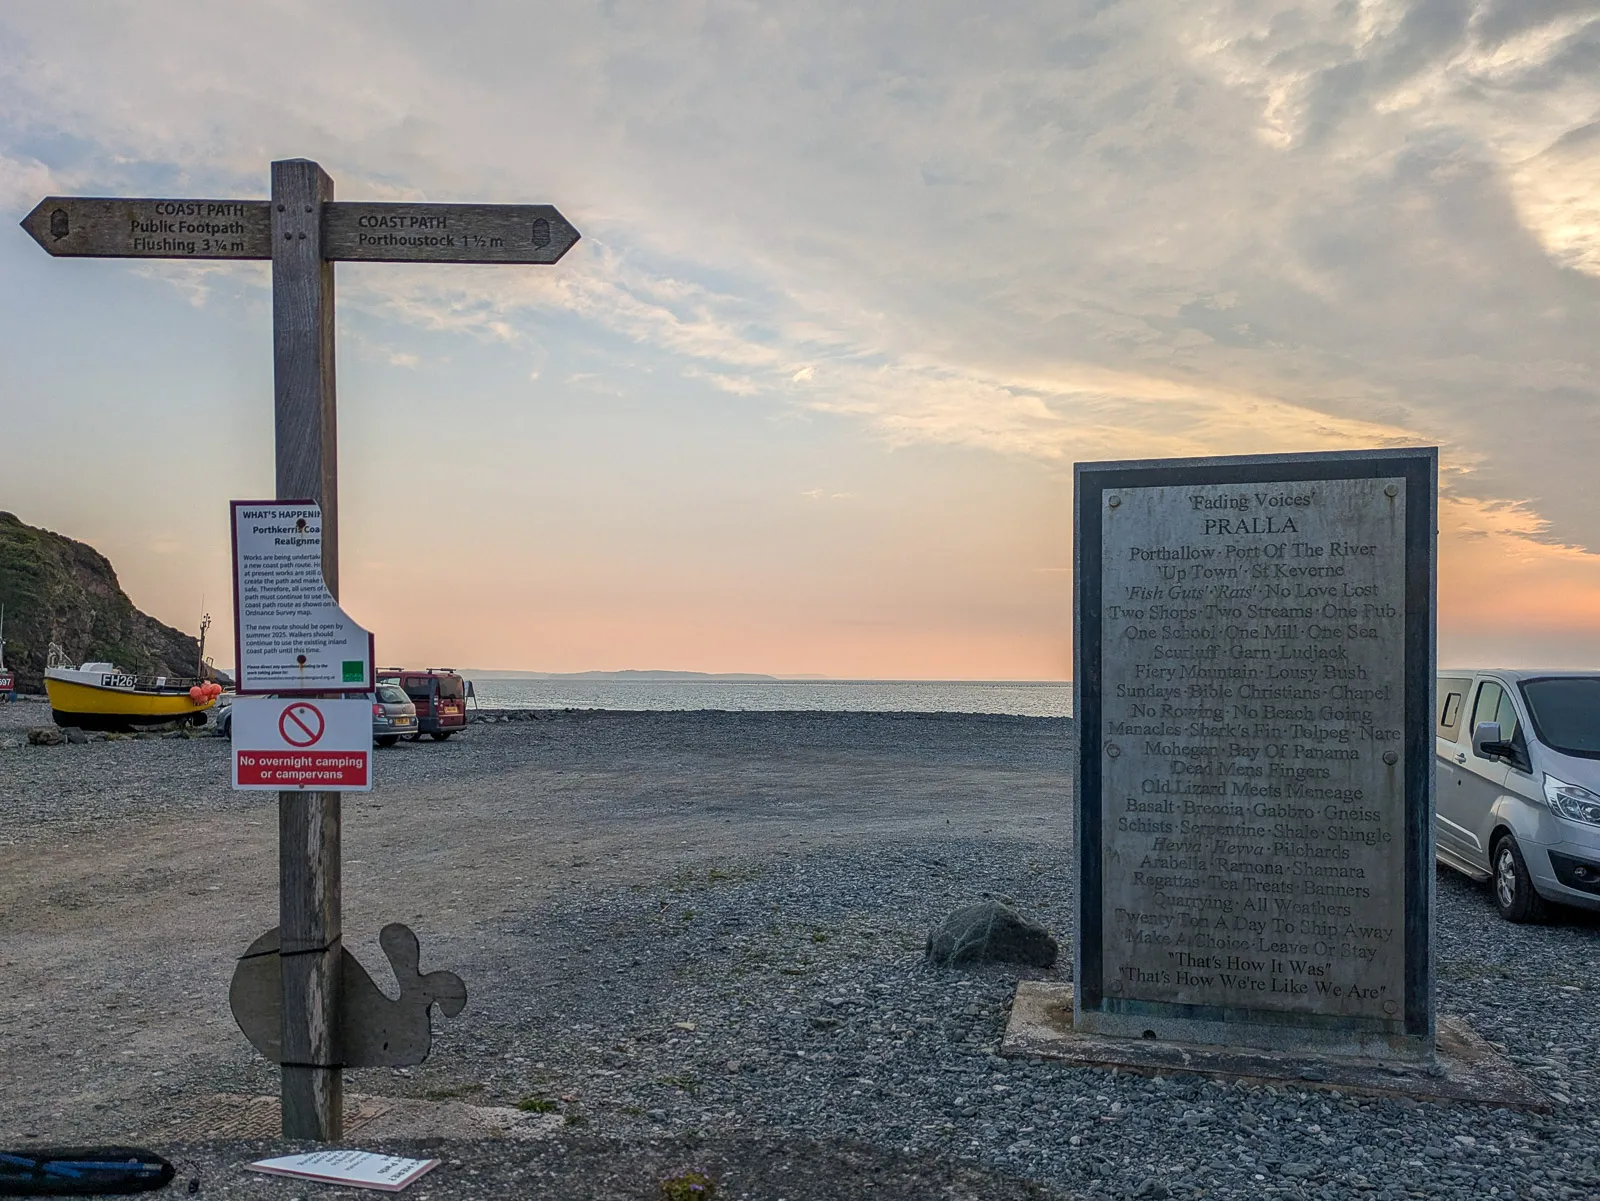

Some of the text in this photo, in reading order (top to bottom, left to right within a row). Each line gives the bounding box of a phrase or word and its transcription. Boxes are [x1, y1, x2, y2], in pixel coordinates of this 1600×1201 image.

[155, 203, 244, 216] COAST PATH
[131, 220, 244, 236] Public Footpath
[358, 216, 447, 229] COAST PATH
[134, 238, 195, 254] Flushing
[231, 242, 244, 251] m
[359, 234, 455, 246] Porthoustock
[490, 237, 503, 247] m
[1204, 516, 1299, 535] PRALLA
[275, 538, 320, 547] Realignme
[1128, 541, 1377, 560] Porthallow Port Of The River
[1252, 564, 1268, 578] St
[1272, 562, 1344, 577] Keverne
[1265, 584, 1290, 598] No
[1298, 583, 1337, 598] Love
[1343, 582, 1378, 597] Lost
[1108, 603, 1396, 622] Two Shops Two Streams One Pub
[1124, 624, 1377, 639] One School One Mill One Sea
[1230, 645, 1270, 659] Garn
[102, 674, 133, 686] FH26
[1135, 665, 1368, 682] Fiery Mountain Lousy Bush
[1116, 684, 1391, 703] Sundays Bible Christians Chapel
[1132, 704, 1372, 724] No Rowing No Beach Going
[1108, 722, 1180, 736] Manacles
[1189, 723, 1248, 737] Shark's
[1253, 724, 1280, 738] Fin
[1359, 725, 1400, 740] Nare
[1144, 742, 1359, 760] Mohegan Bay Of Panama
[240, 756, 363, 768] No overnight camping
[260, 770, 343, 780] or campervans
[1172, 761, 1330, 782] Dead Mens Fingers
[1142, 780, 1170, 794] Old
[1176, 780, 1226, 795] Lizard
[1232, 782, 1280, 797] Meets
[1125, 799, 1174, 814] Basalt
[1252, 803, 1314, 819] Gabbro
[1324, 805, 1380, 821] Gneiss
[1118, 818, 1172, 834] Schists
[1273, 824, 1318, 839] Shale
[1327, 826, 1392, 845] Shingle
[1273, 842, 1349, 859] Pilchards
[1140, 855, 1364, 878] Arabella Ramona Shamara
[1133, 872, 1369, 897] Regattas Tea Treats Banners
[1243, 897, 1267, 912] All
[1274, 898, 1350, 916] Weathers
[1178, 913, 1208, 928] Ton
[1214, 915, 1228, 929] A
[1233, 916, 1266, 935] Day
[1272, 918, 1294, 933] To
[1300, 920, 1337, 939] Ship
[1343, 922, 1393, 942] Away
[1175, 932, 1187, 946] A
[1259, 937, 1307, 954] Leave
[1314, 940, 1334, 956] Or
[1341, 942, 1376, 962] Stay
[1226, 955, 1265, 972] How
[1271, 958, 1282, 973] It
[1176, 971, 1213, 987] How
[1219, 974, 1265, 991] We're
[1272, 978, 1308, 994] Like
[1315, 980, 1341, 997] We
